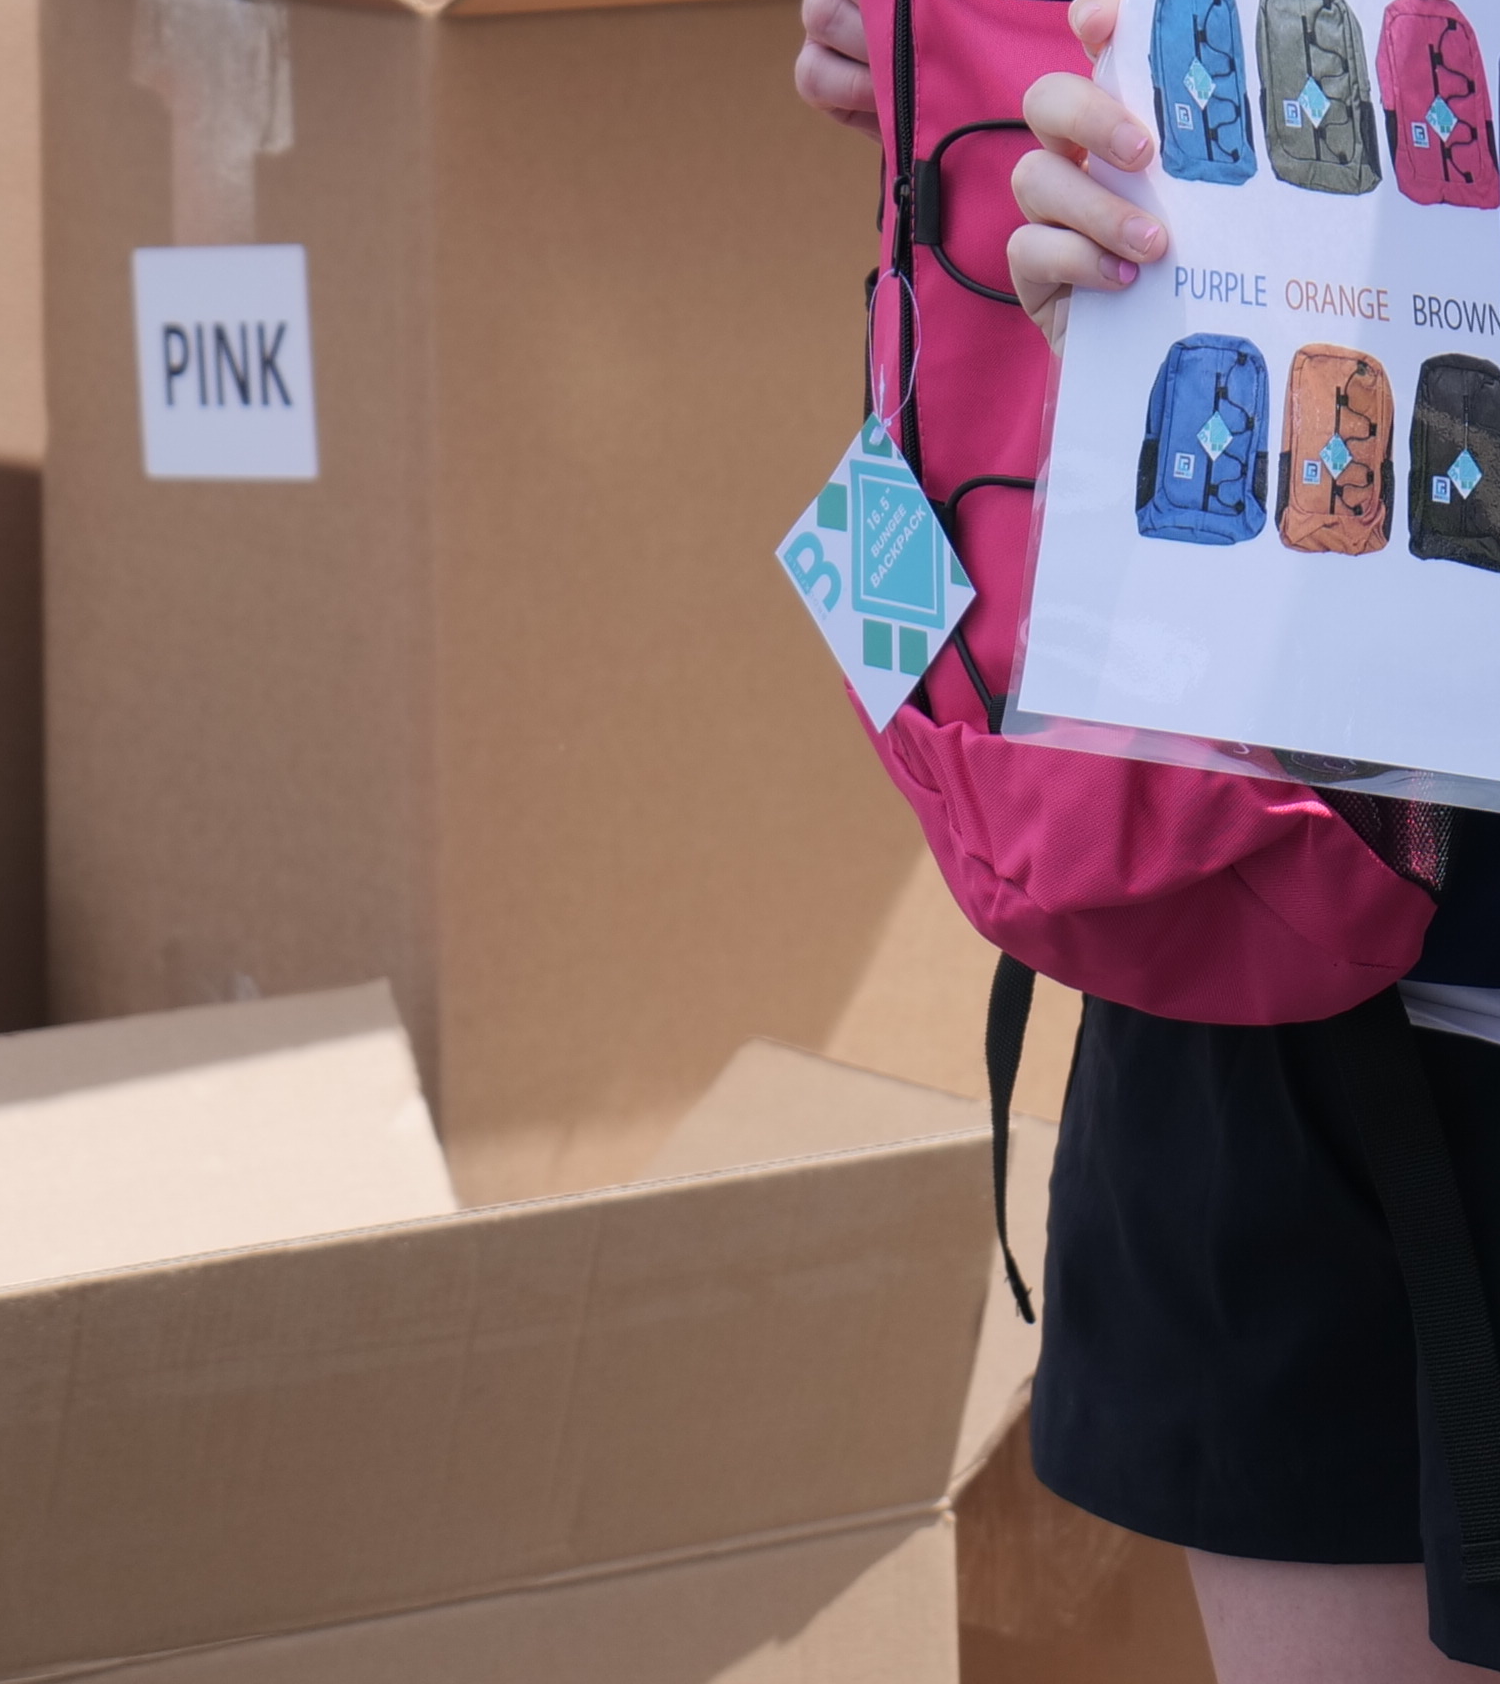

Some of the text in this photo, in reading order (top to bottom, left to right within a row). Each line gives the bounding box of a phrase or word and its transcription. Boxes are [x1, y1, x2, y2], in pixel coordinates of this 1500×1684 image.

[1174, 267, 1267, 306] PURPLE
[1285, 279, 1390, 322] ORANGE
[162, 321, 292, 406] PINK
[870, 504, 927, 588] BACKPACK
[871, 503, 907, 558] BUNGEE
